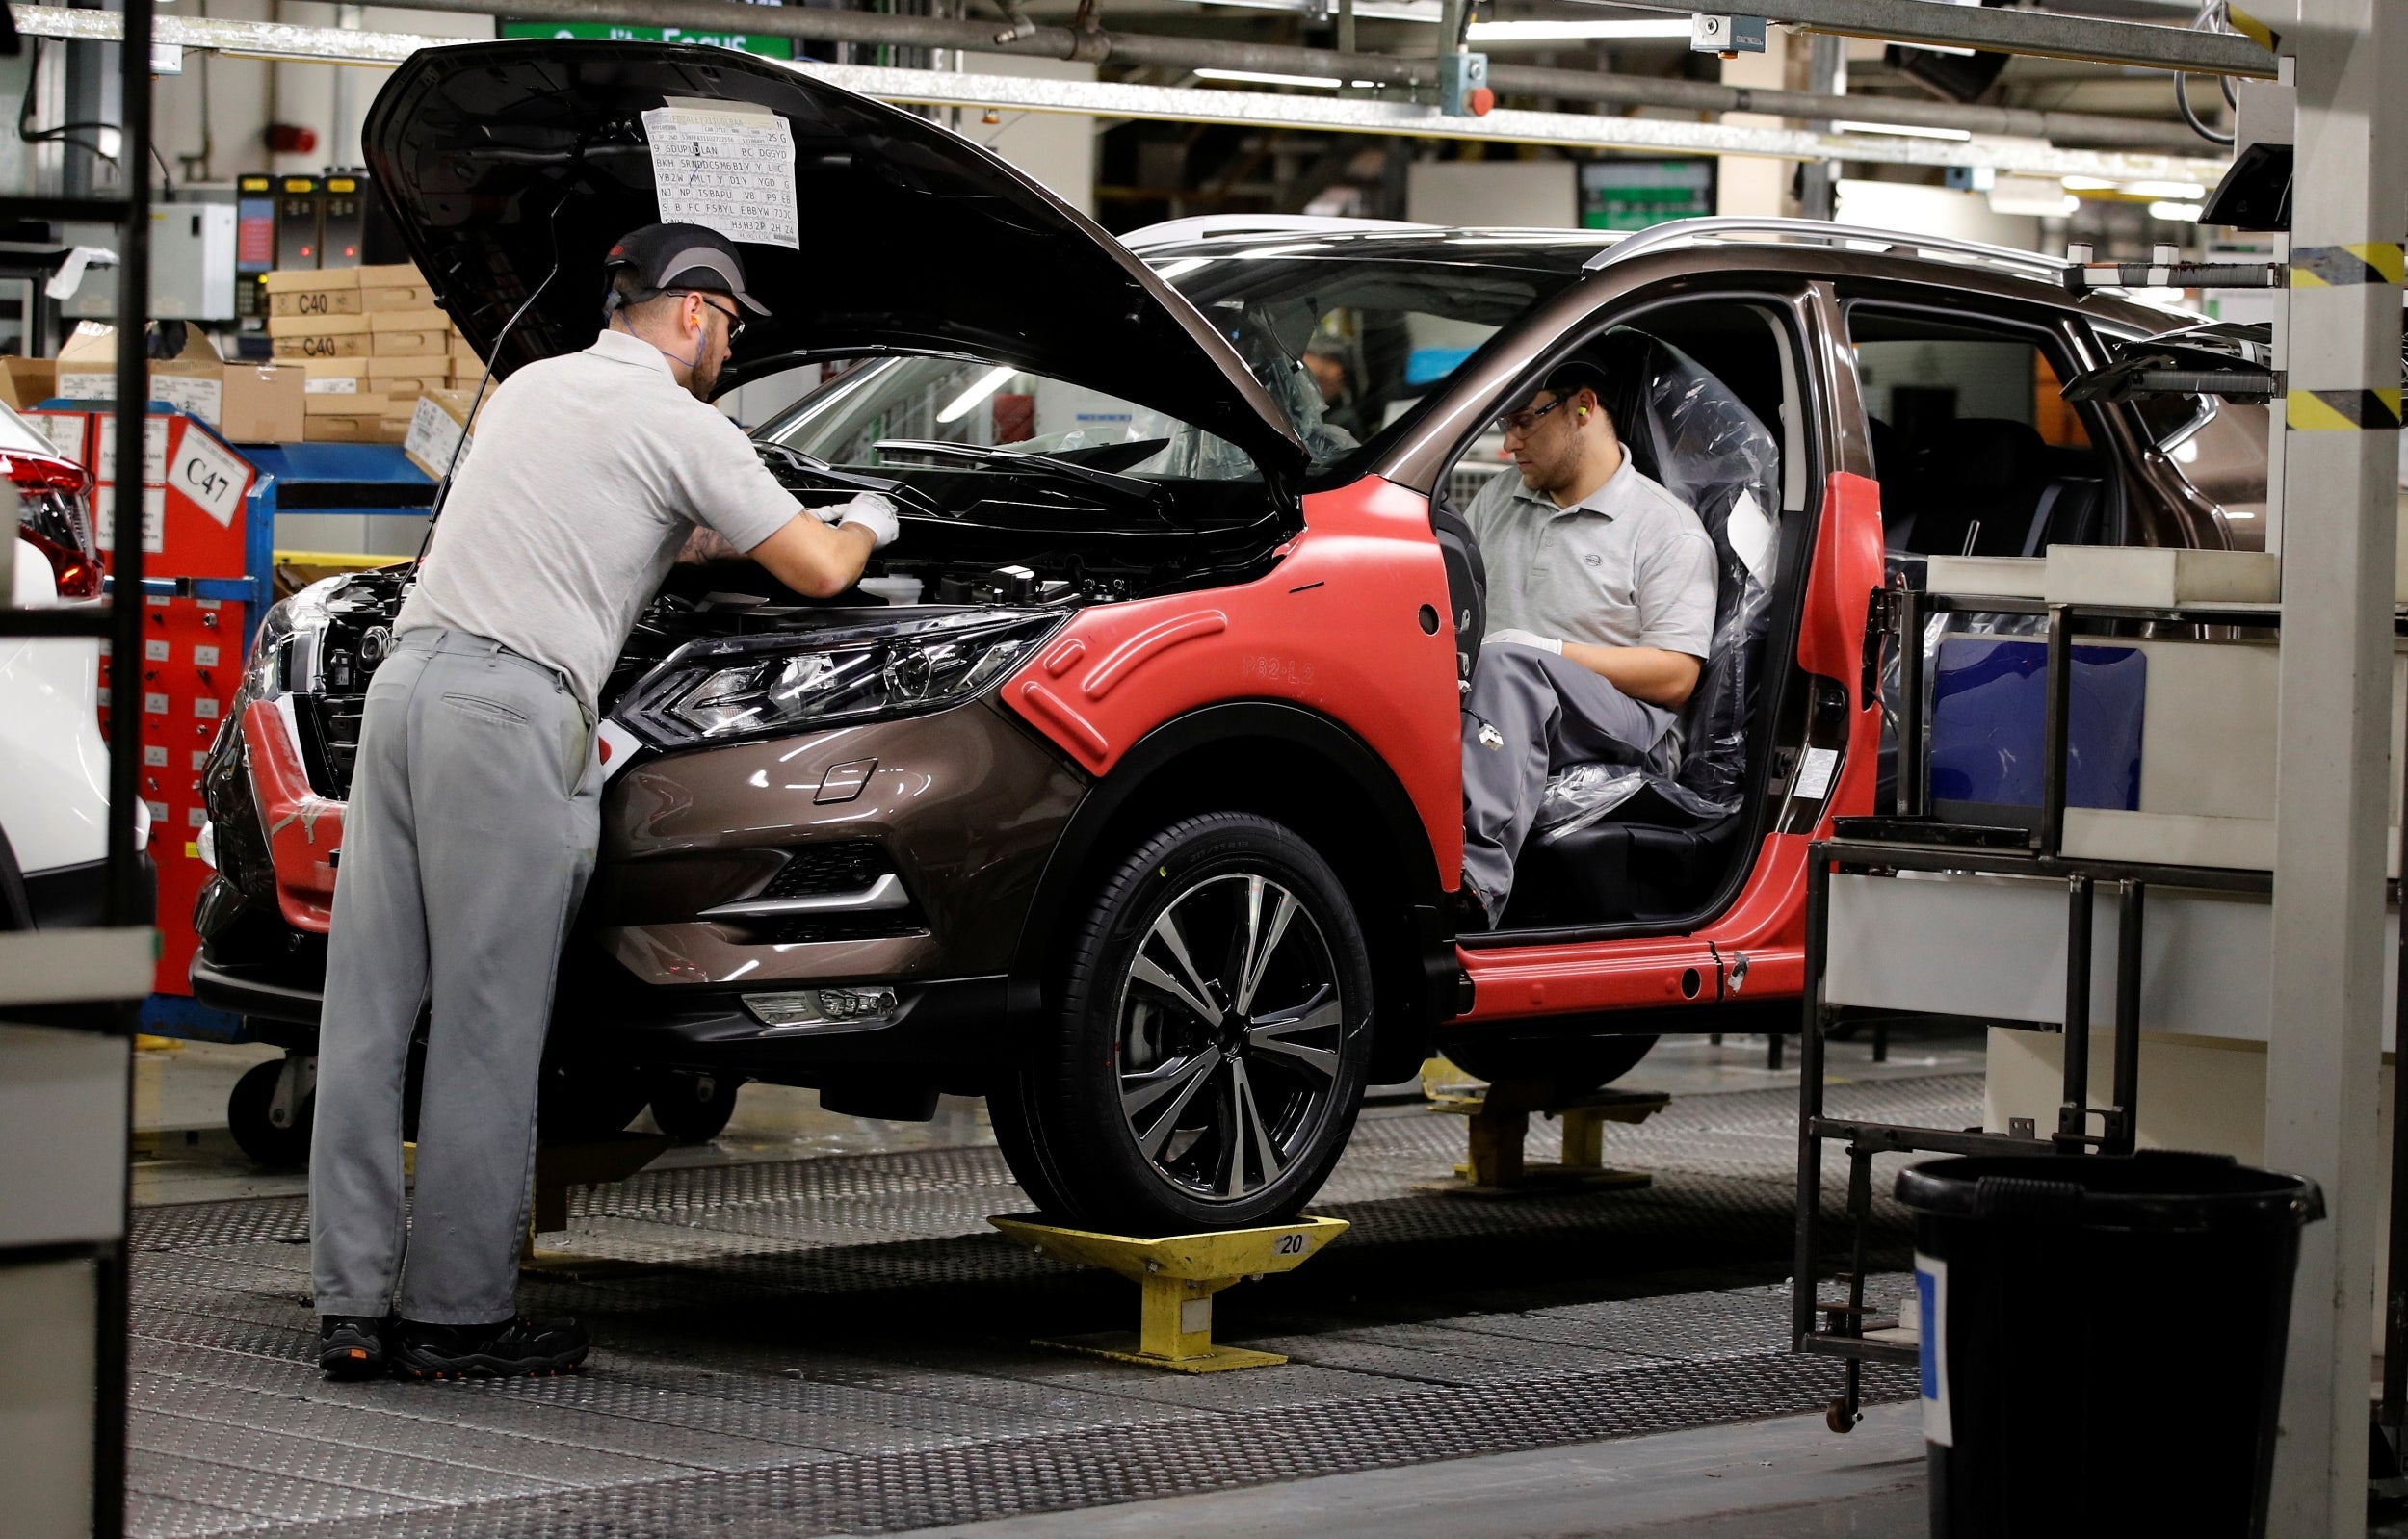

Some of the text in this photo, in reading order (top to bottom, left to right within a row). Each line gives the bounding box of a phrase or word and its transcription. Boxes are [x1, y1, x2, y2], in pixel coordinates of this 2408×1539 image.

[300, 293, 327, 314] C40
[303, 337, 335, 357] C40
[187, 457, 230, 503] C47
[1280, 1234, 1303, 1254] 20
